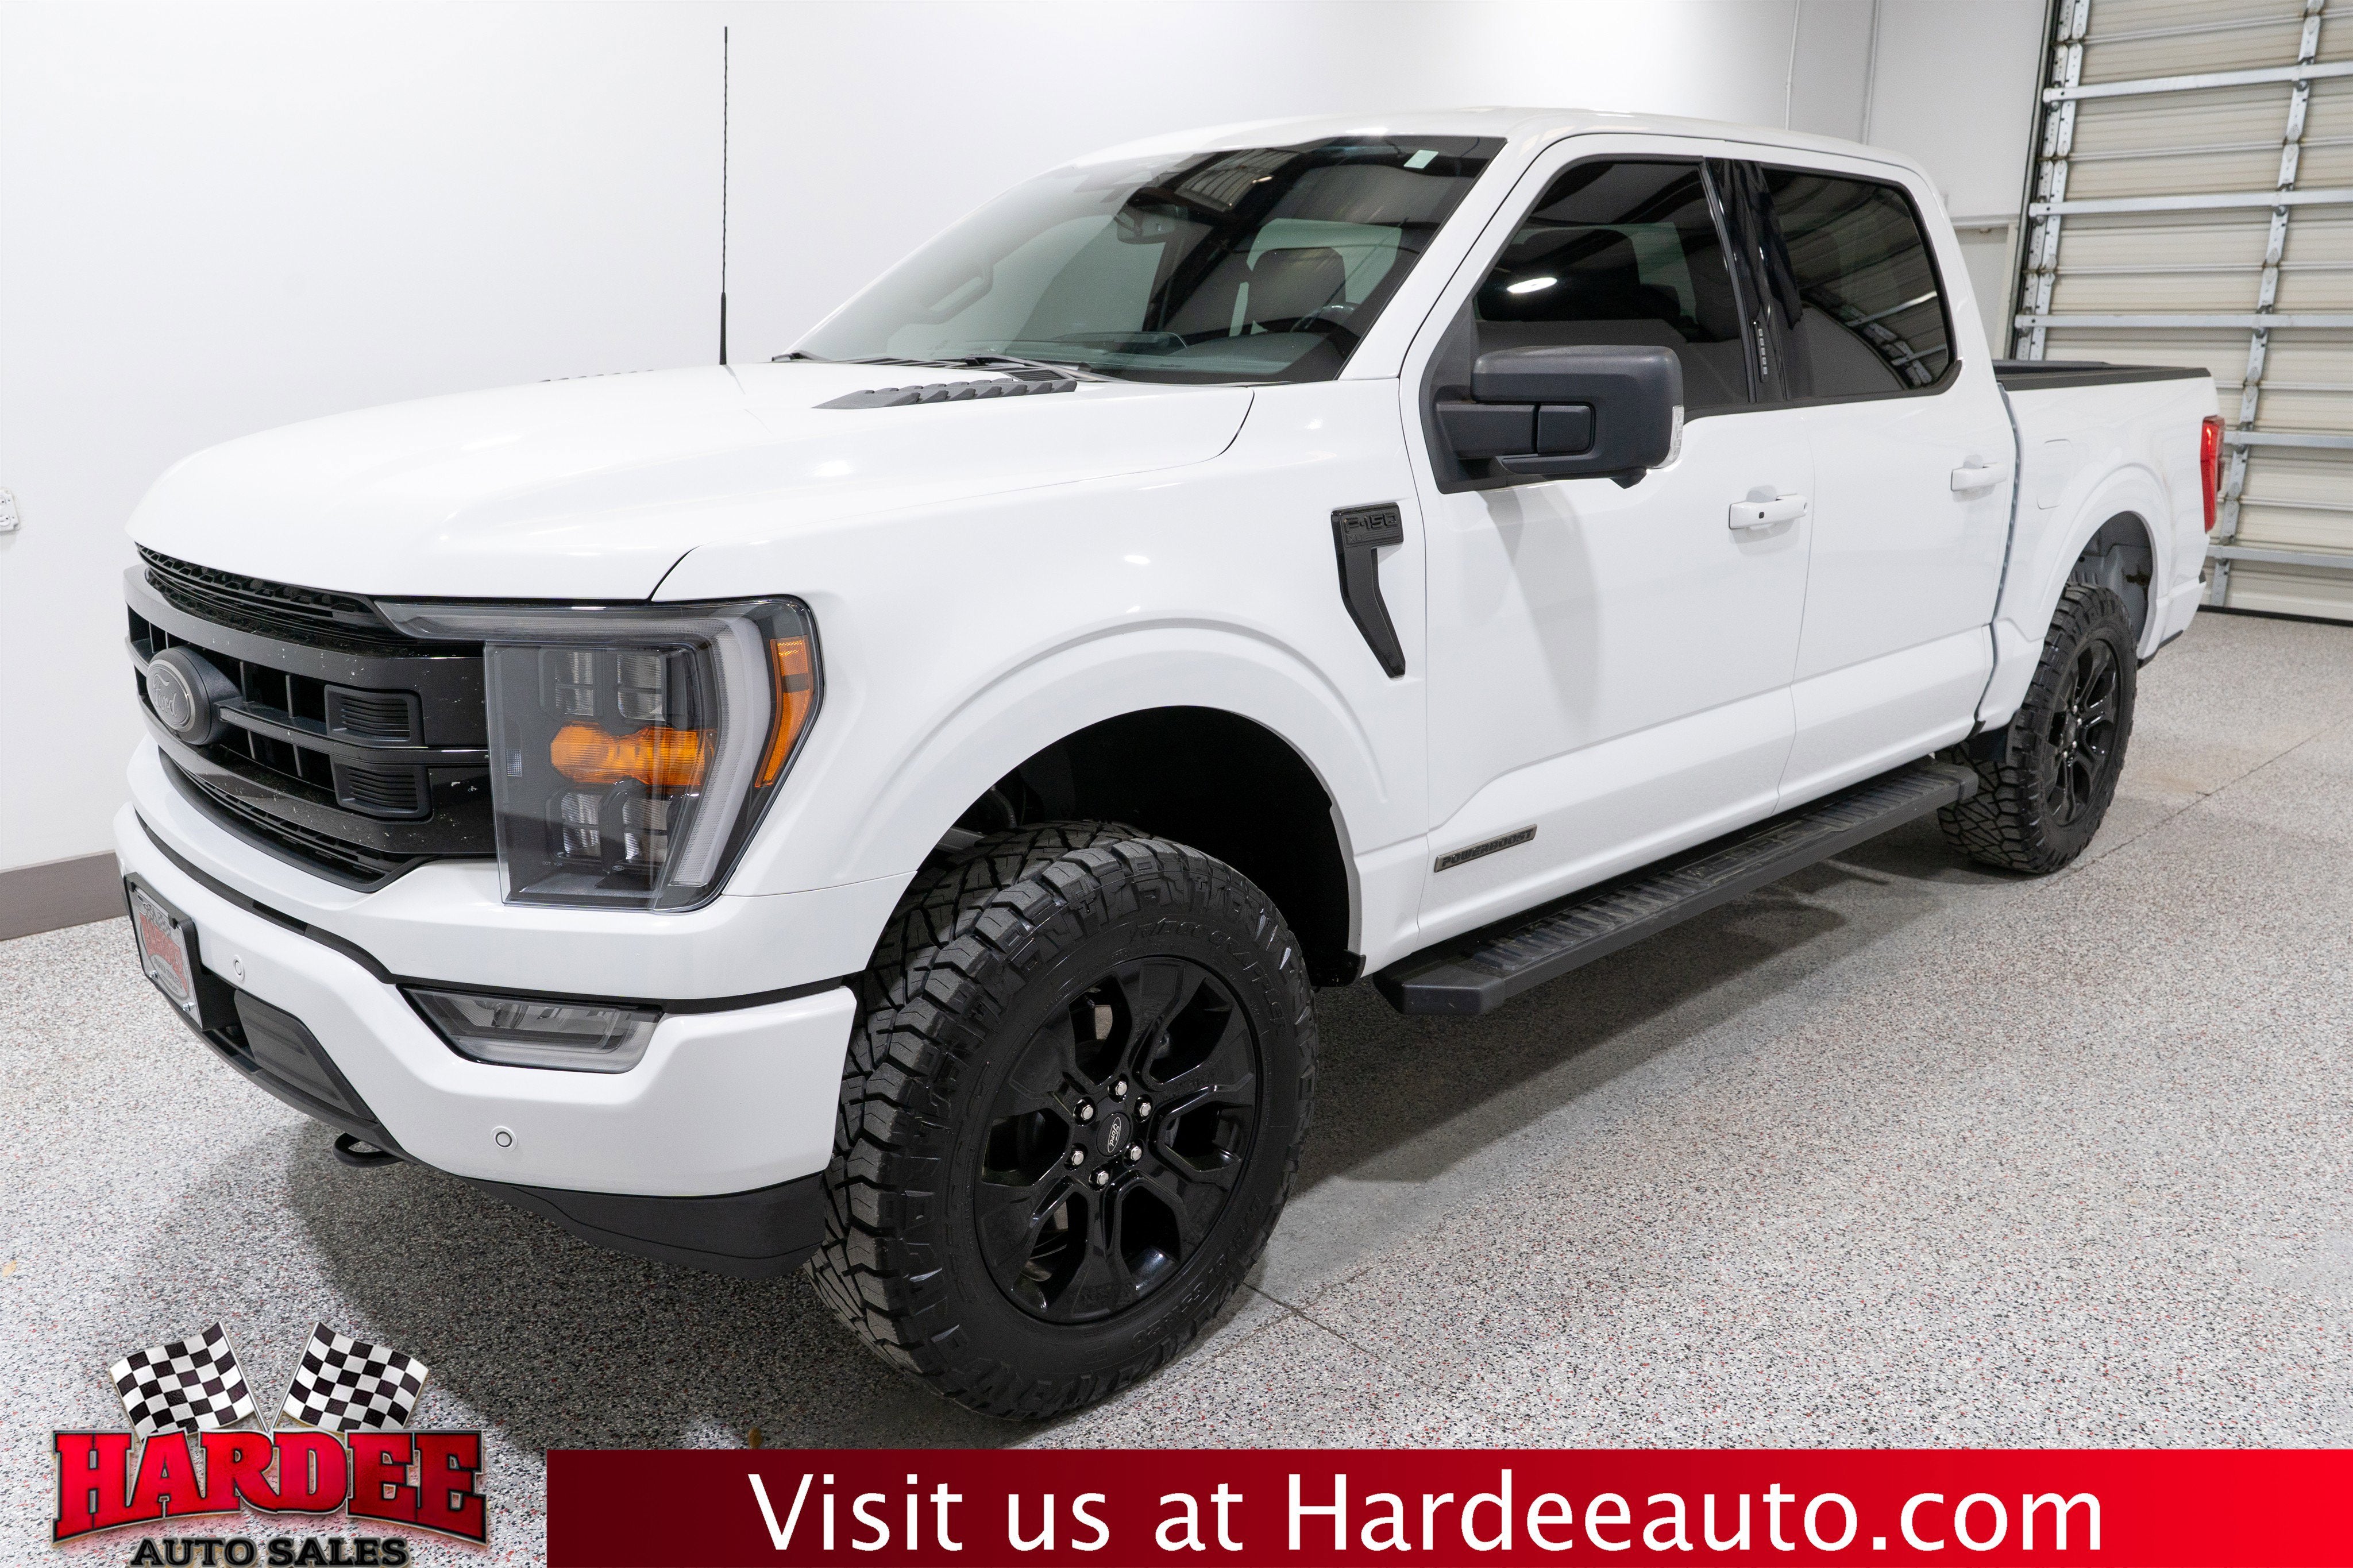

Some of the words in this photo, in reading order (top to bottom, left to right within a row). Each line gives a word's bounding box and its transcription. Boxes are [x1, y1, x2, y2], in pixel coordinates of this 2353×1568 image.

[1344, 511, 1398, 533] F-150
[152, 674, 178, 717] Ford
[1442, 828, 1534, 868] POWERBOOST
[1109, 1123, 1121, 1147] Ford
